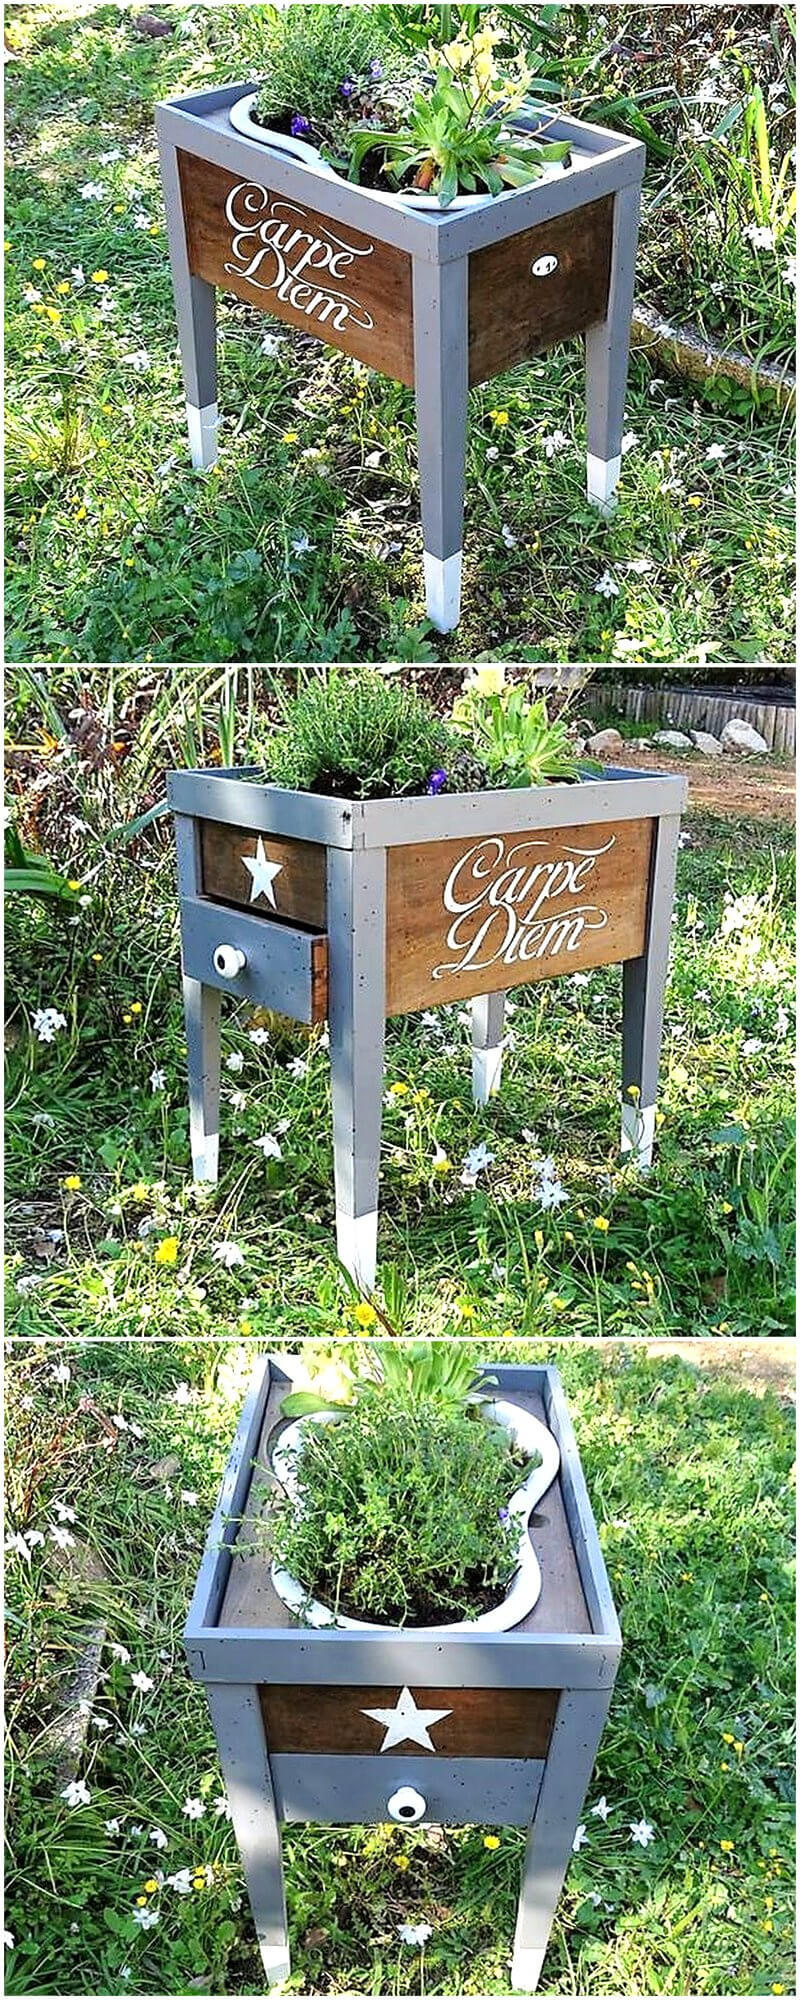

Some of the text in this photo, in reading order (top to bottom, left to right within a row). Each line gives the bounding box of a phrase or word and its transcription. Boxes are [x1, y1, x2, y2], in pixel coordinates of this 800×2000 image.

[225, 182, 374, 279] Carpe
[224, 232, 374, 331] Diem
[443, 835, 616, 924] Carpe
[432, 902, 608, 979] Diem
